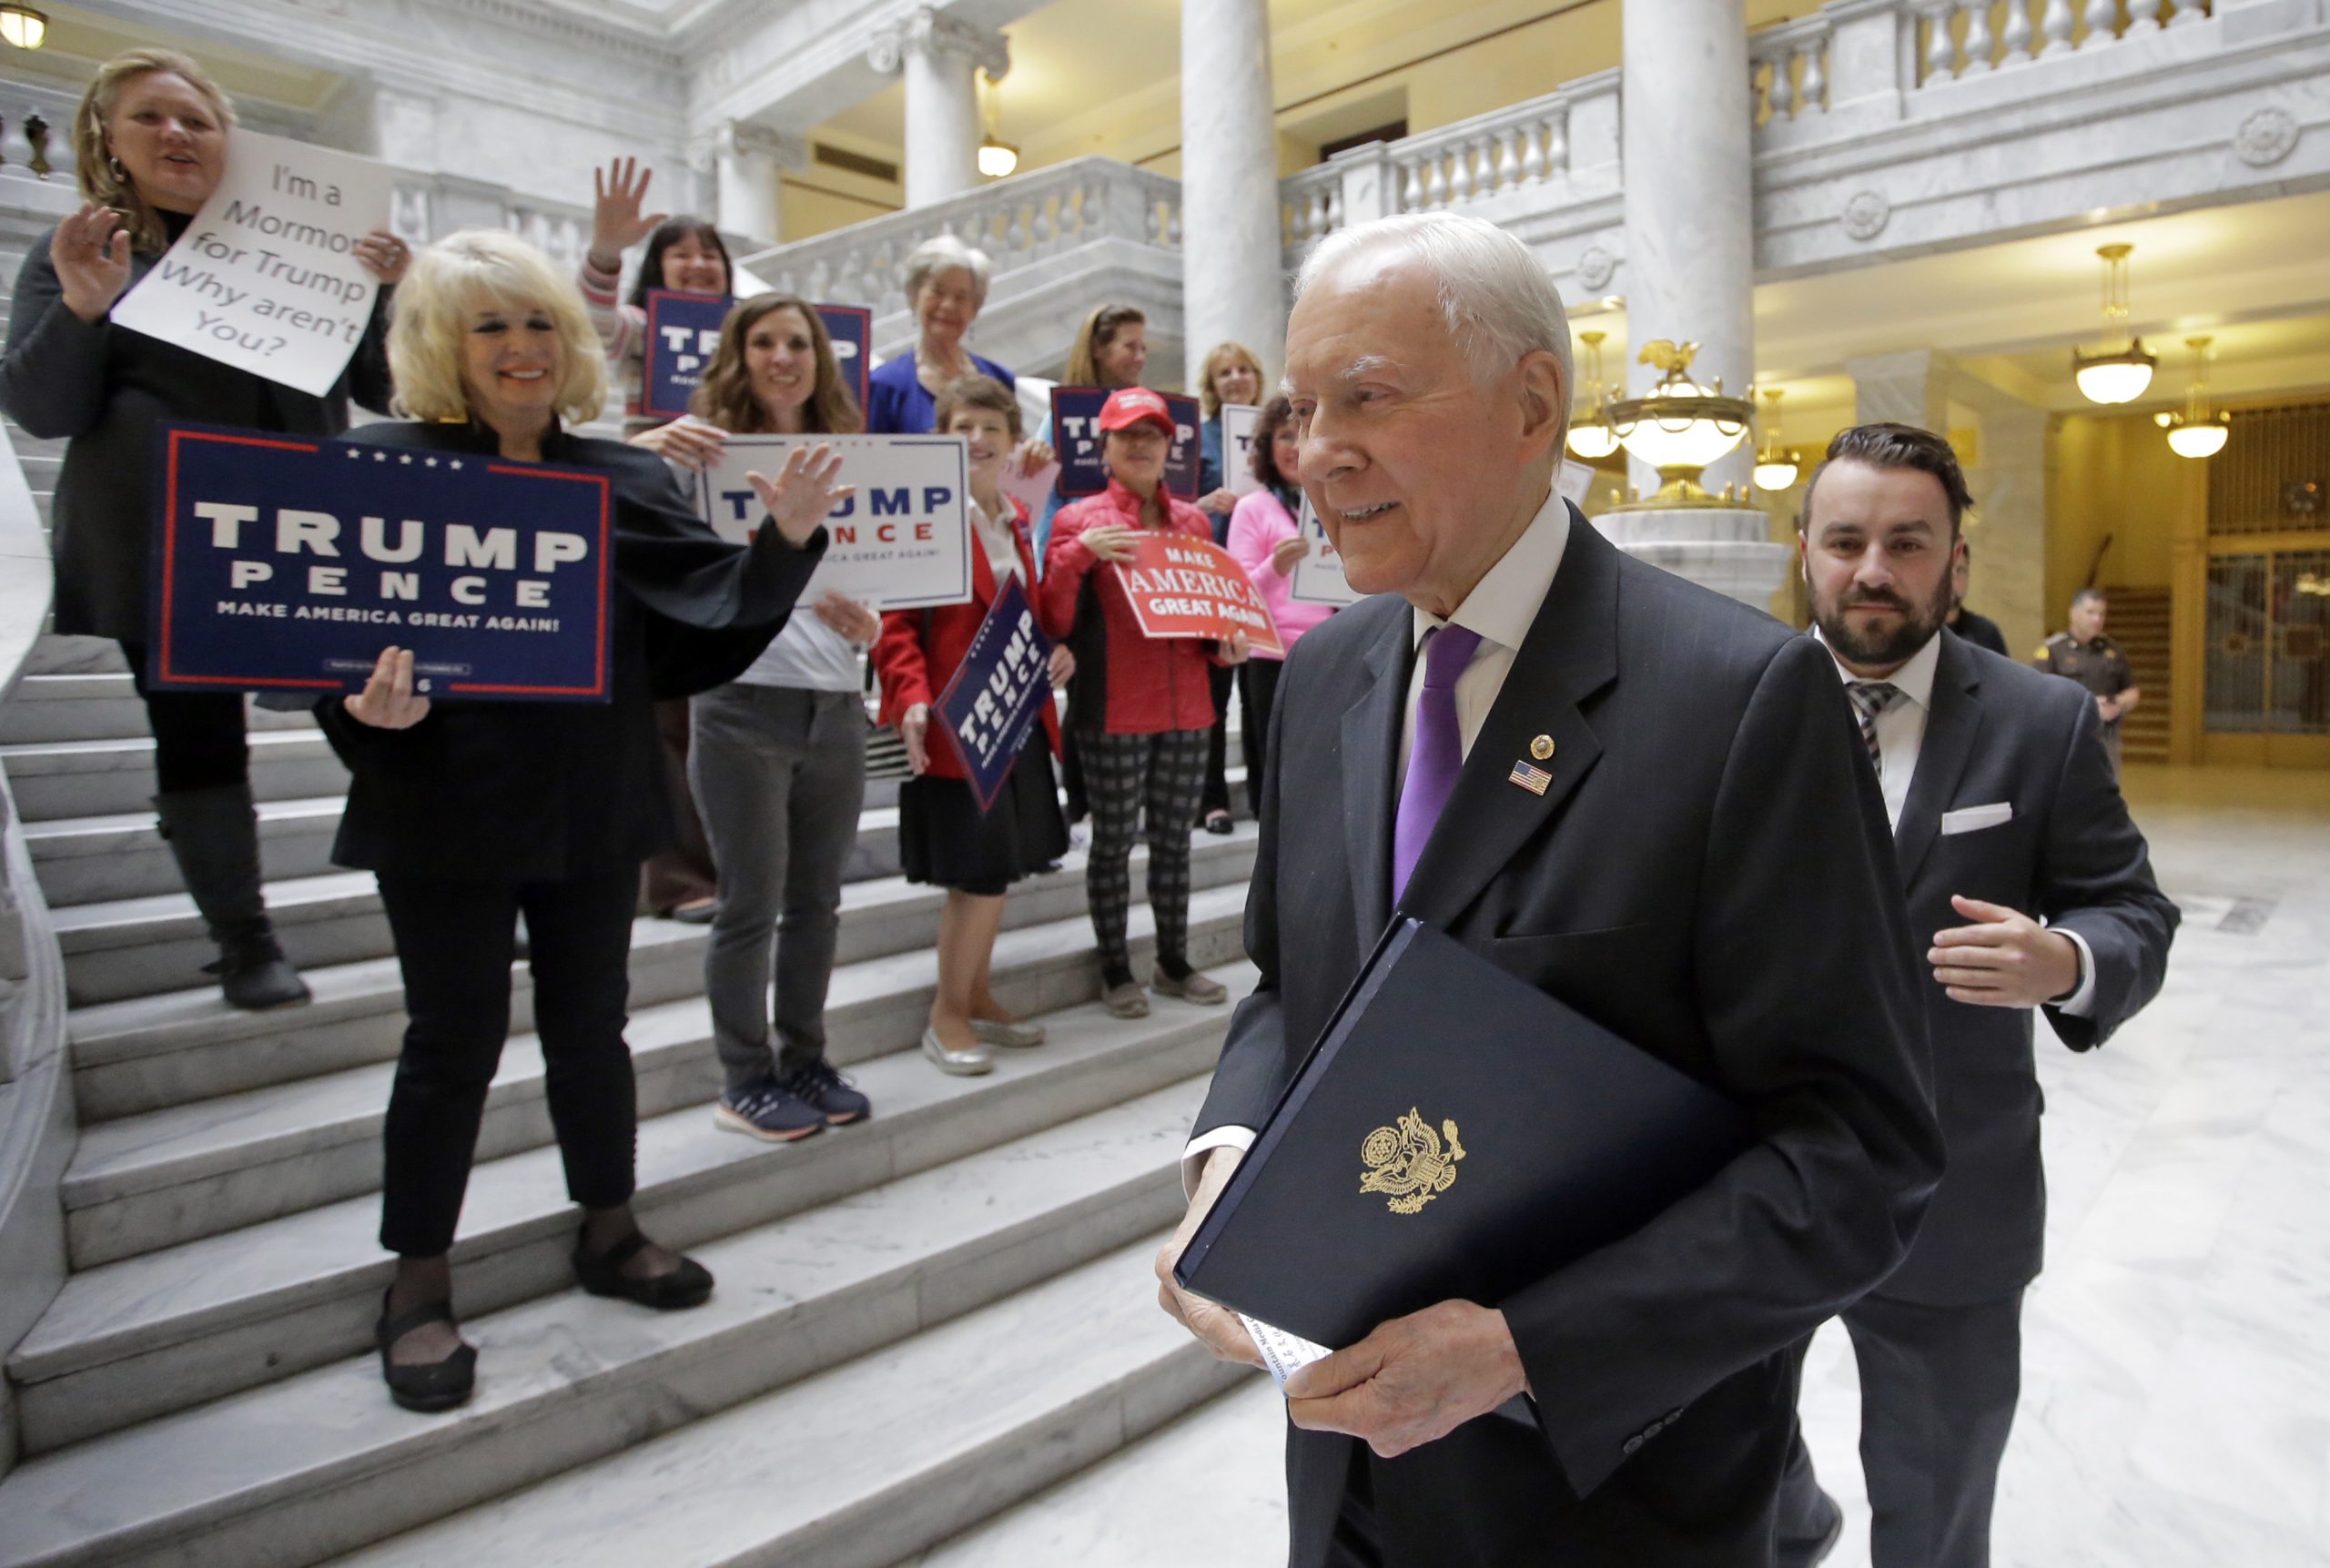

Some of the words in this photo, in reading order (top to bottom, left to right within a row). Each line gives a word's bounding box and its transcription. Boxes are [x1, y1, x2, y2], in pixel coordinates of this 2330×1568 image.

[272, 164, 317, 201] I'm
[326, 185, 342, 207] a
[223, 199, 359, 255] Mormo
[191, 232, 248, 265] for
[258, 249, 367, 306] Trump
[162, 260, 248, 307] Why
[252, 296, 362, 345] aren't
[196, 310, 288, 357] You?
[722, 487, 951, 520] TUMP
[194, 501, 588, 573] TRUMP
[1165, 547, 1217, 569] MAKE
[230, 560, 552, 608] PENCE
[1130, 567, 1268, 610] AMERICA
[217, 601, 288, 619] MAKE
[294, 605, 402, 625] AMERICA
[408, 612, 481, 629] GREAT
[485, 616, 561, 633] AGAIN!
[1149, 597, 1213, 616] GREAT
[1217, 602, 1268, 630] AGAIN
[958, 609, 1033, 744] TRUMP
[977, 642, 1041, 754] PENCE
[1252, 1323, 1268, 1346] Media
[1266, 1346, 1288, 1383] ountain
